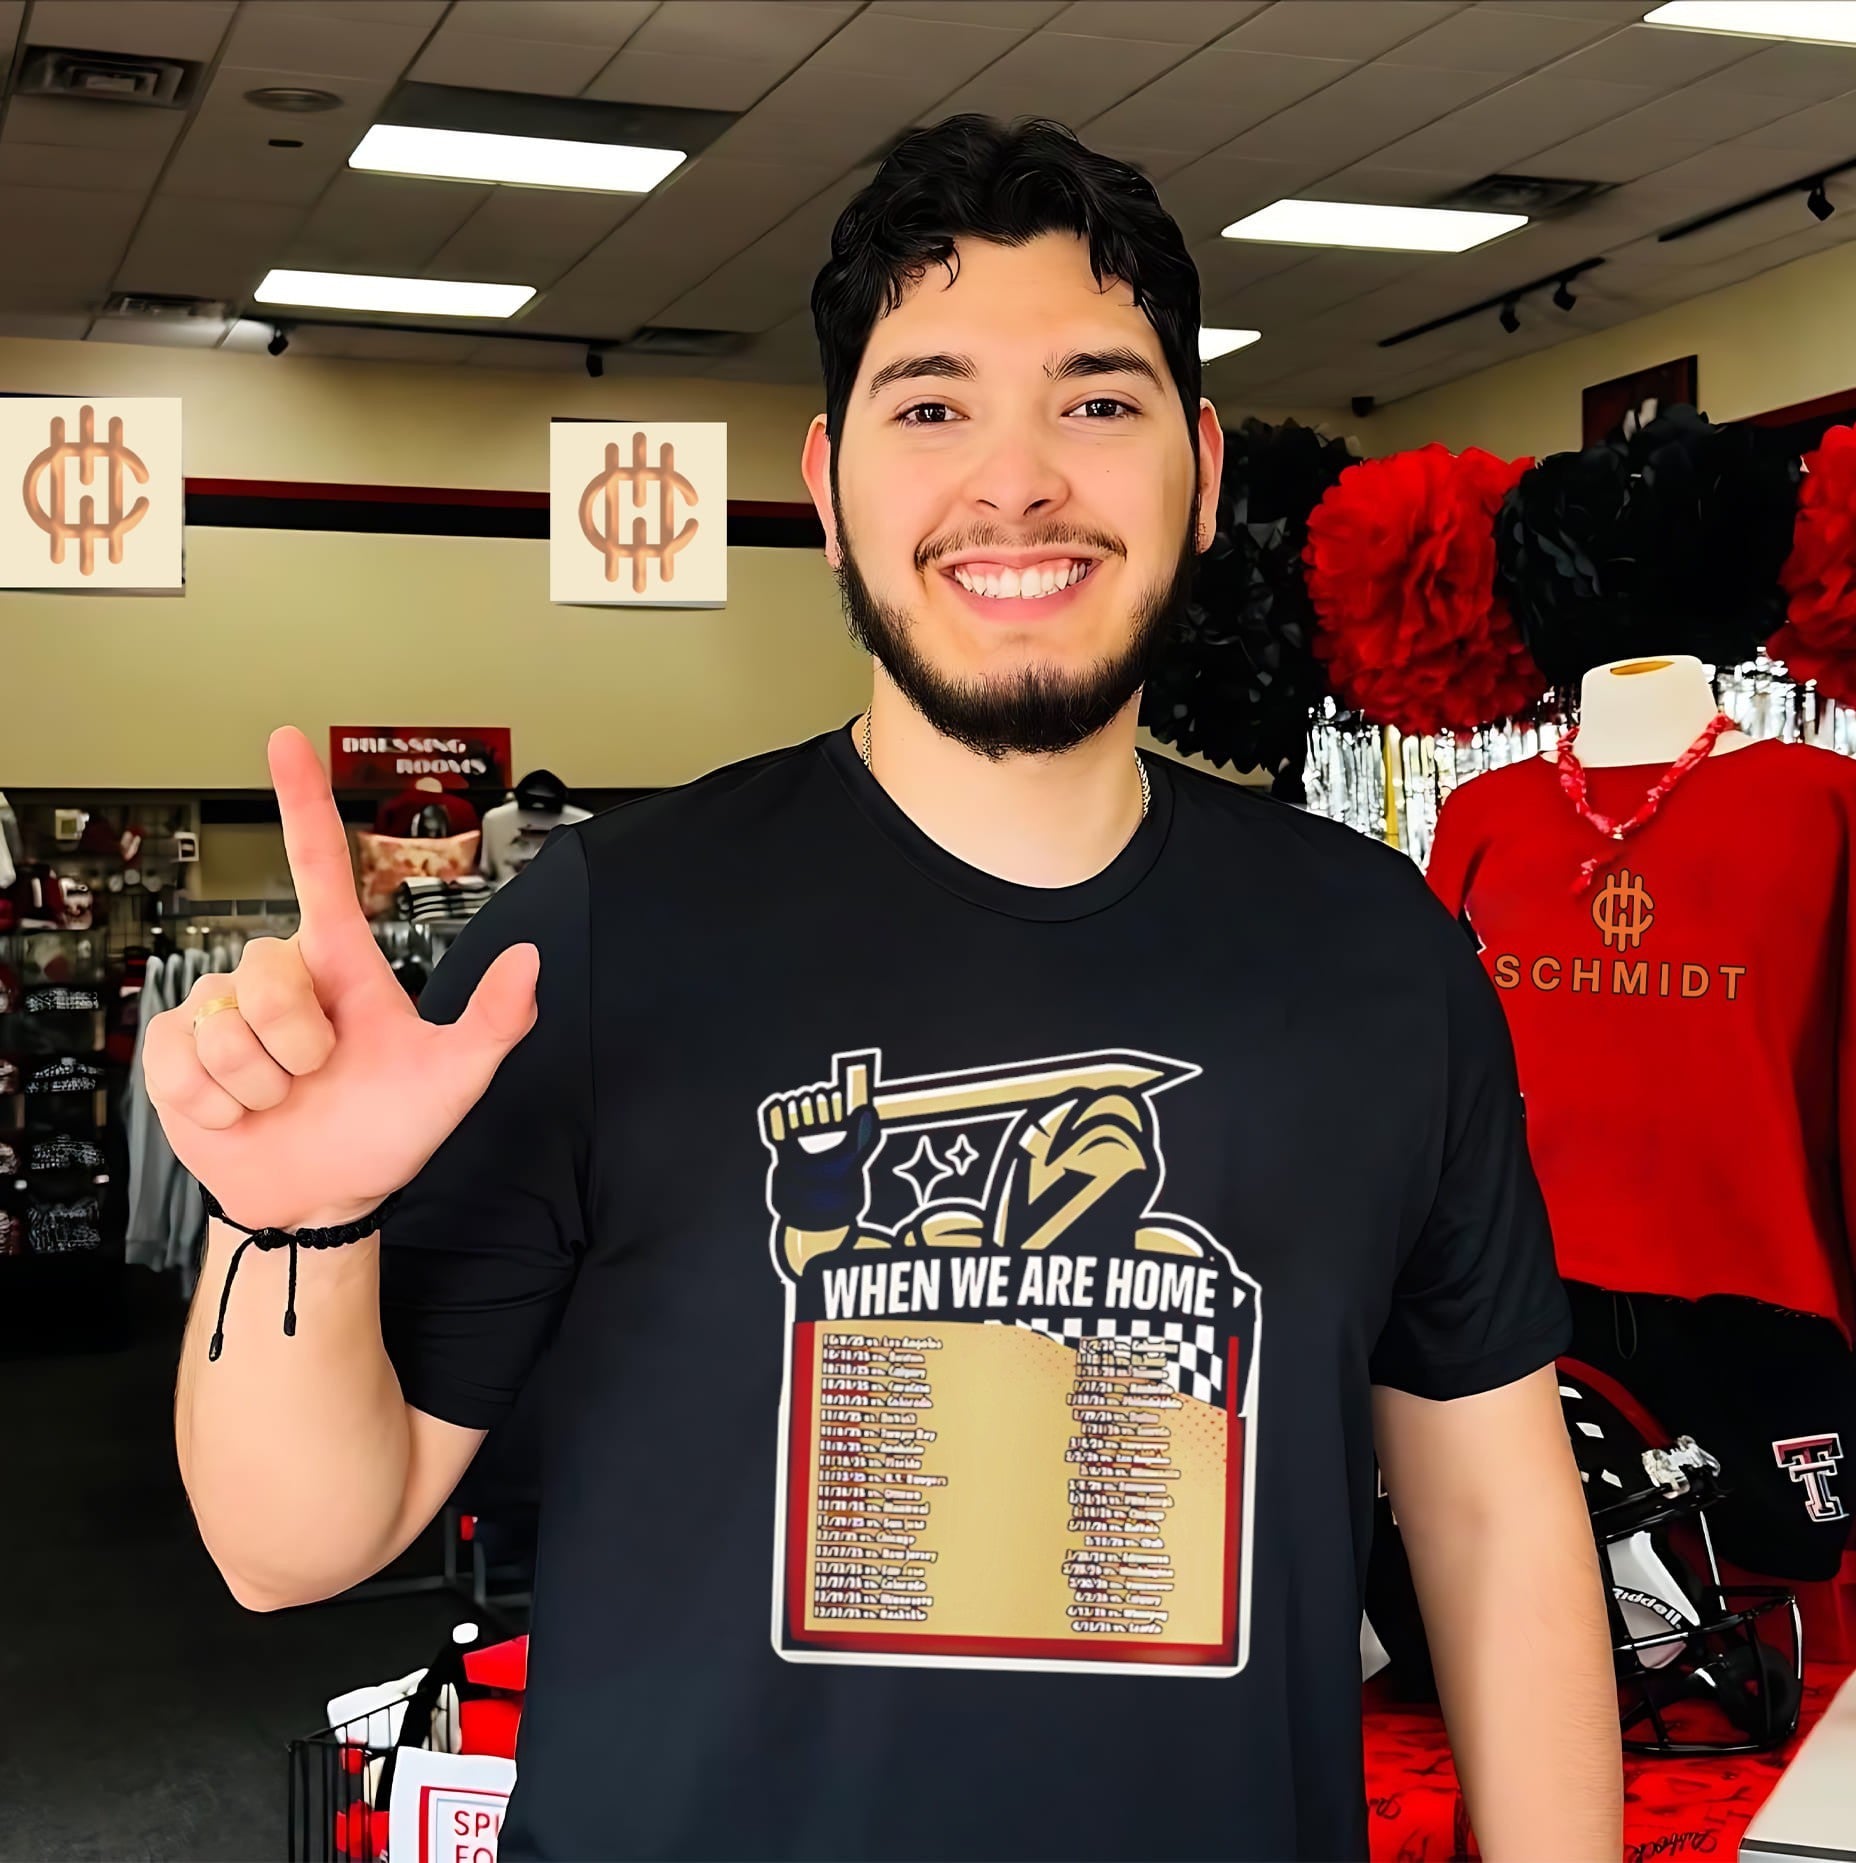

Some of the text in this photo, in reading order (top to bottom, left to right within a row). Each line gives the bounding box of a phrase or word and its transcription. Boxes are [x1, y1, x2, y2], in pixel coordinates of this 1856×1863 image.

[342, 737, 467, 754] DRESSING
[396, 758, 487, 775] ROOMS
[1494, 955, 1746, 1000] SCHMIDT
[822, 1255, 1219, 1320] WHEN WE ARE HOME
